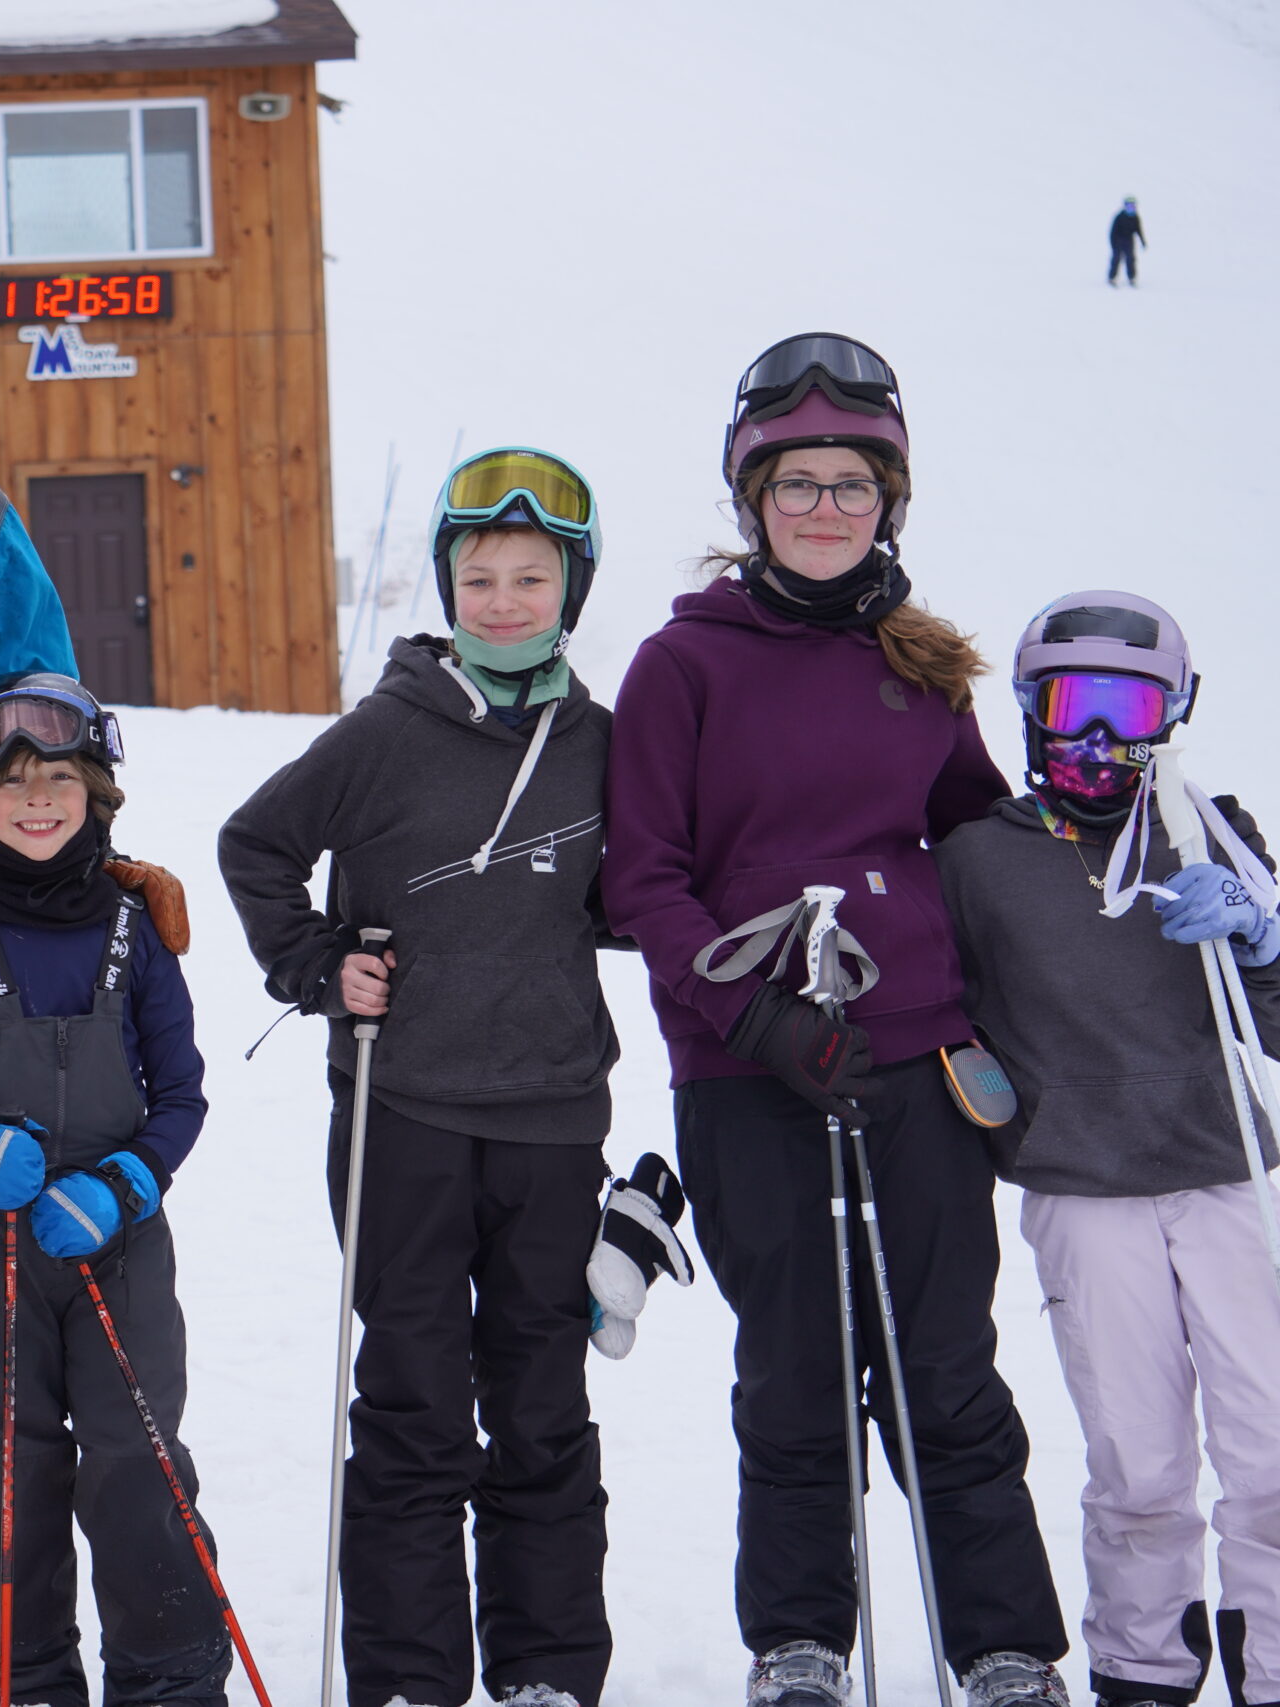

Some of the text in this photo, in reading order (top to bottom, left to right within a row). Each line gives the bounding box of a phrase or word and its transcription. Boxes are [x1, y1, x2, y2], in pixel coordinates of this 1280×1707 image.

[811, 923, 830, 942] LEKI
[974, 1070, 1013, 1096] JBL
[131, 1386, 169, 1460] SCOTT
